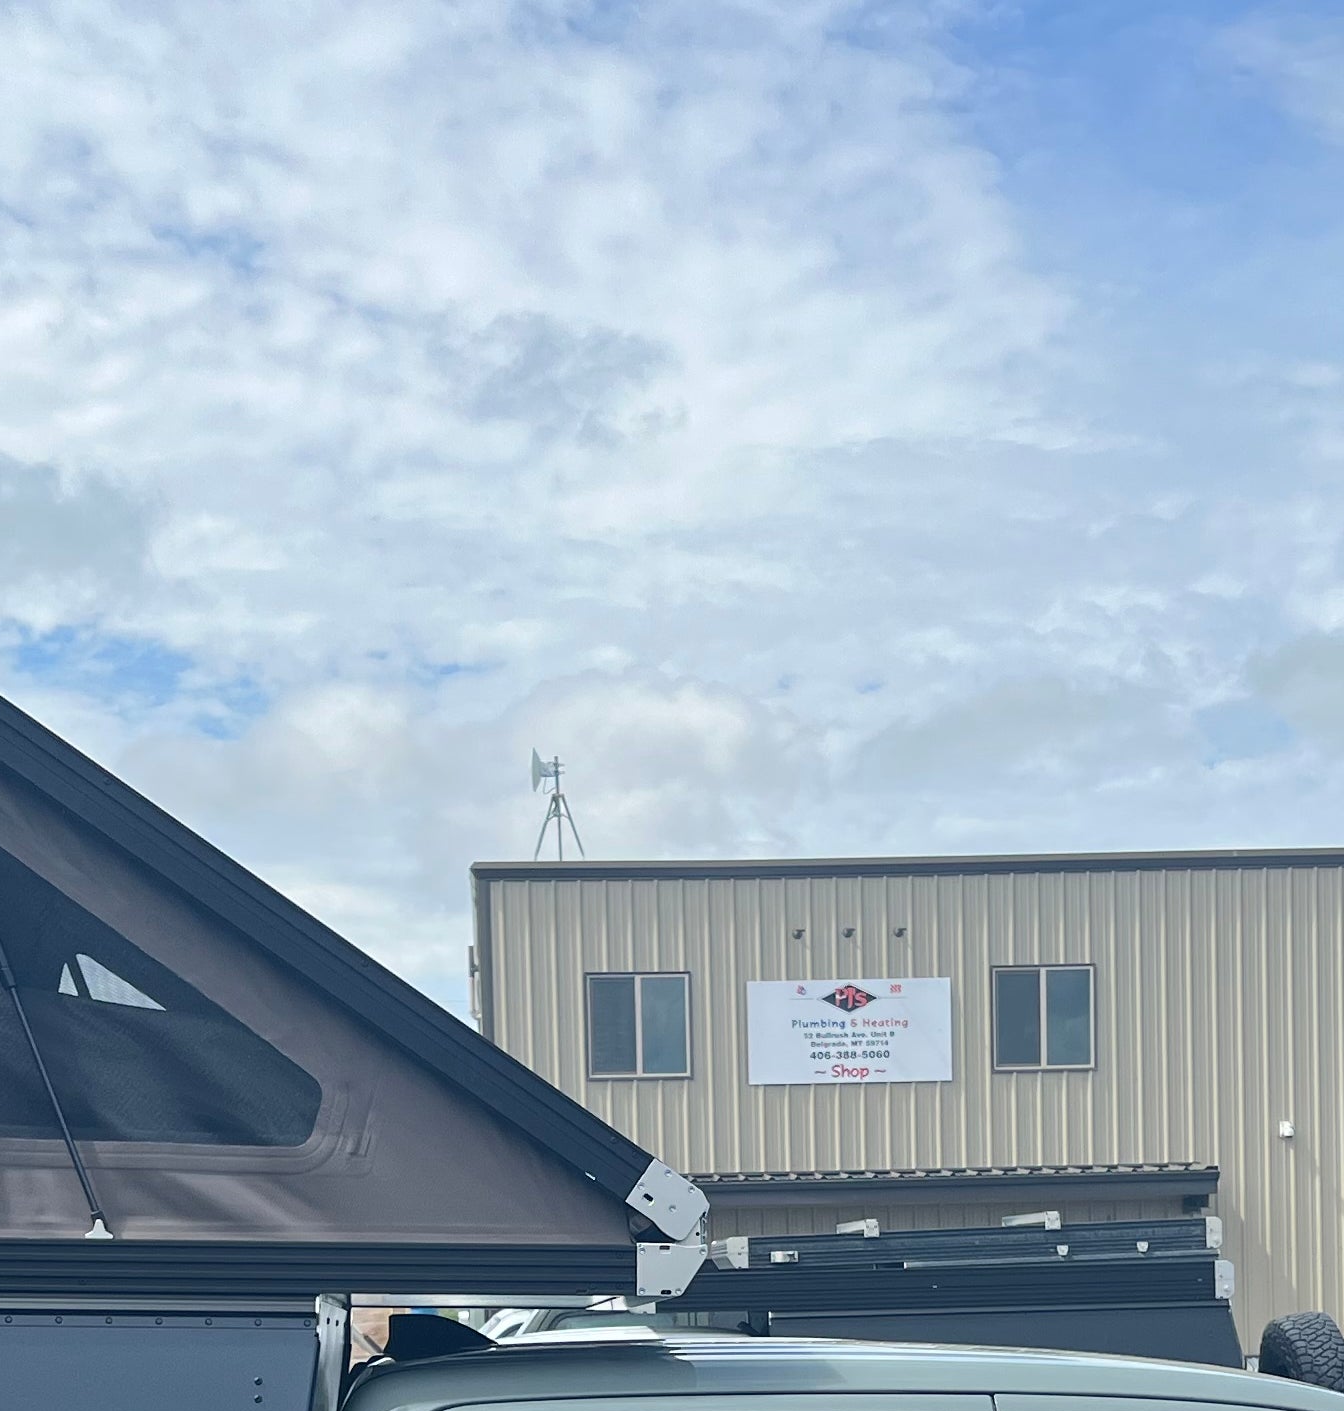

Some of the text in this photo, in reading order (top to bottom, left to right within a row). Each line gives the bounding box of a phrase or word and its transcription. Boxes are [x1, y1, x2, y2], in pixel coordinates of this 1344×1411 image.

[791, 1019, 846, 1029] Plumbing
[862, 1018, 909, 1029] Heating
[809, 1049, 890, 1060] 406-388-5060
[831, 1063, 870, 1080] Shop
